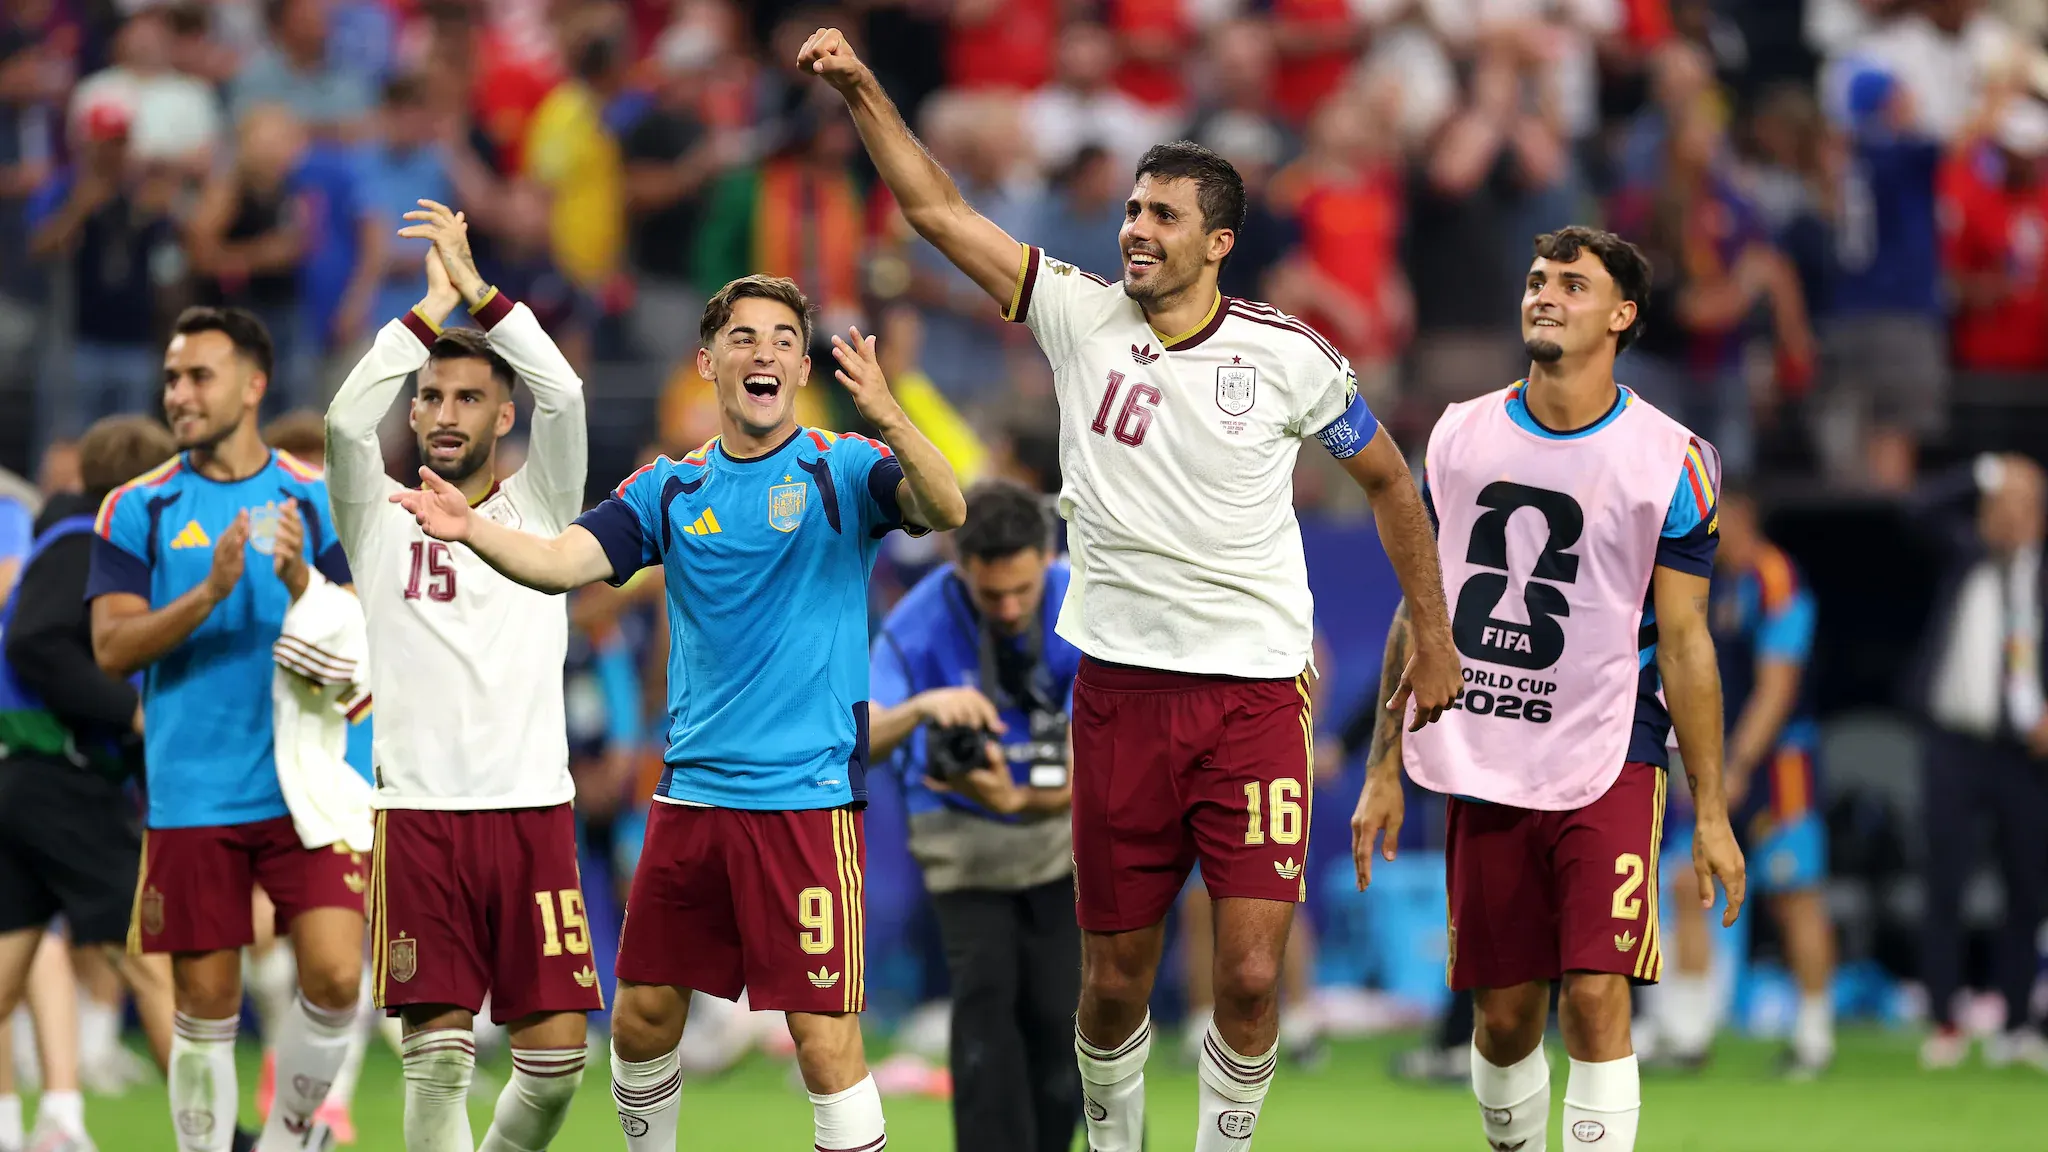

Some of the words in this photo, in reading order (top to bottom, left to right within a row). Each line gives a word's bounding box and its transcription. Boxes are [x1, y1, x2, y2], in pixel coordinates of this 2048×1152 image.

[1090, 369, 1163, 448] 16
[1317, 418, 1348, 439] OTBALL
[1320, 424, 1352, 447] NITES
[404, 541, 456, 602] 15
[1481, 626, 1532, 654] FIFA
[1461, 667, 1513, 689] ORLD
[1517, 678, 1557, 696] CUP
[1244, 778, 1302, 845] 16
[1611, 853, 1644, 920] 2
[535, 889, 589, 957] 15
[799, 887, 834, 954] 9
